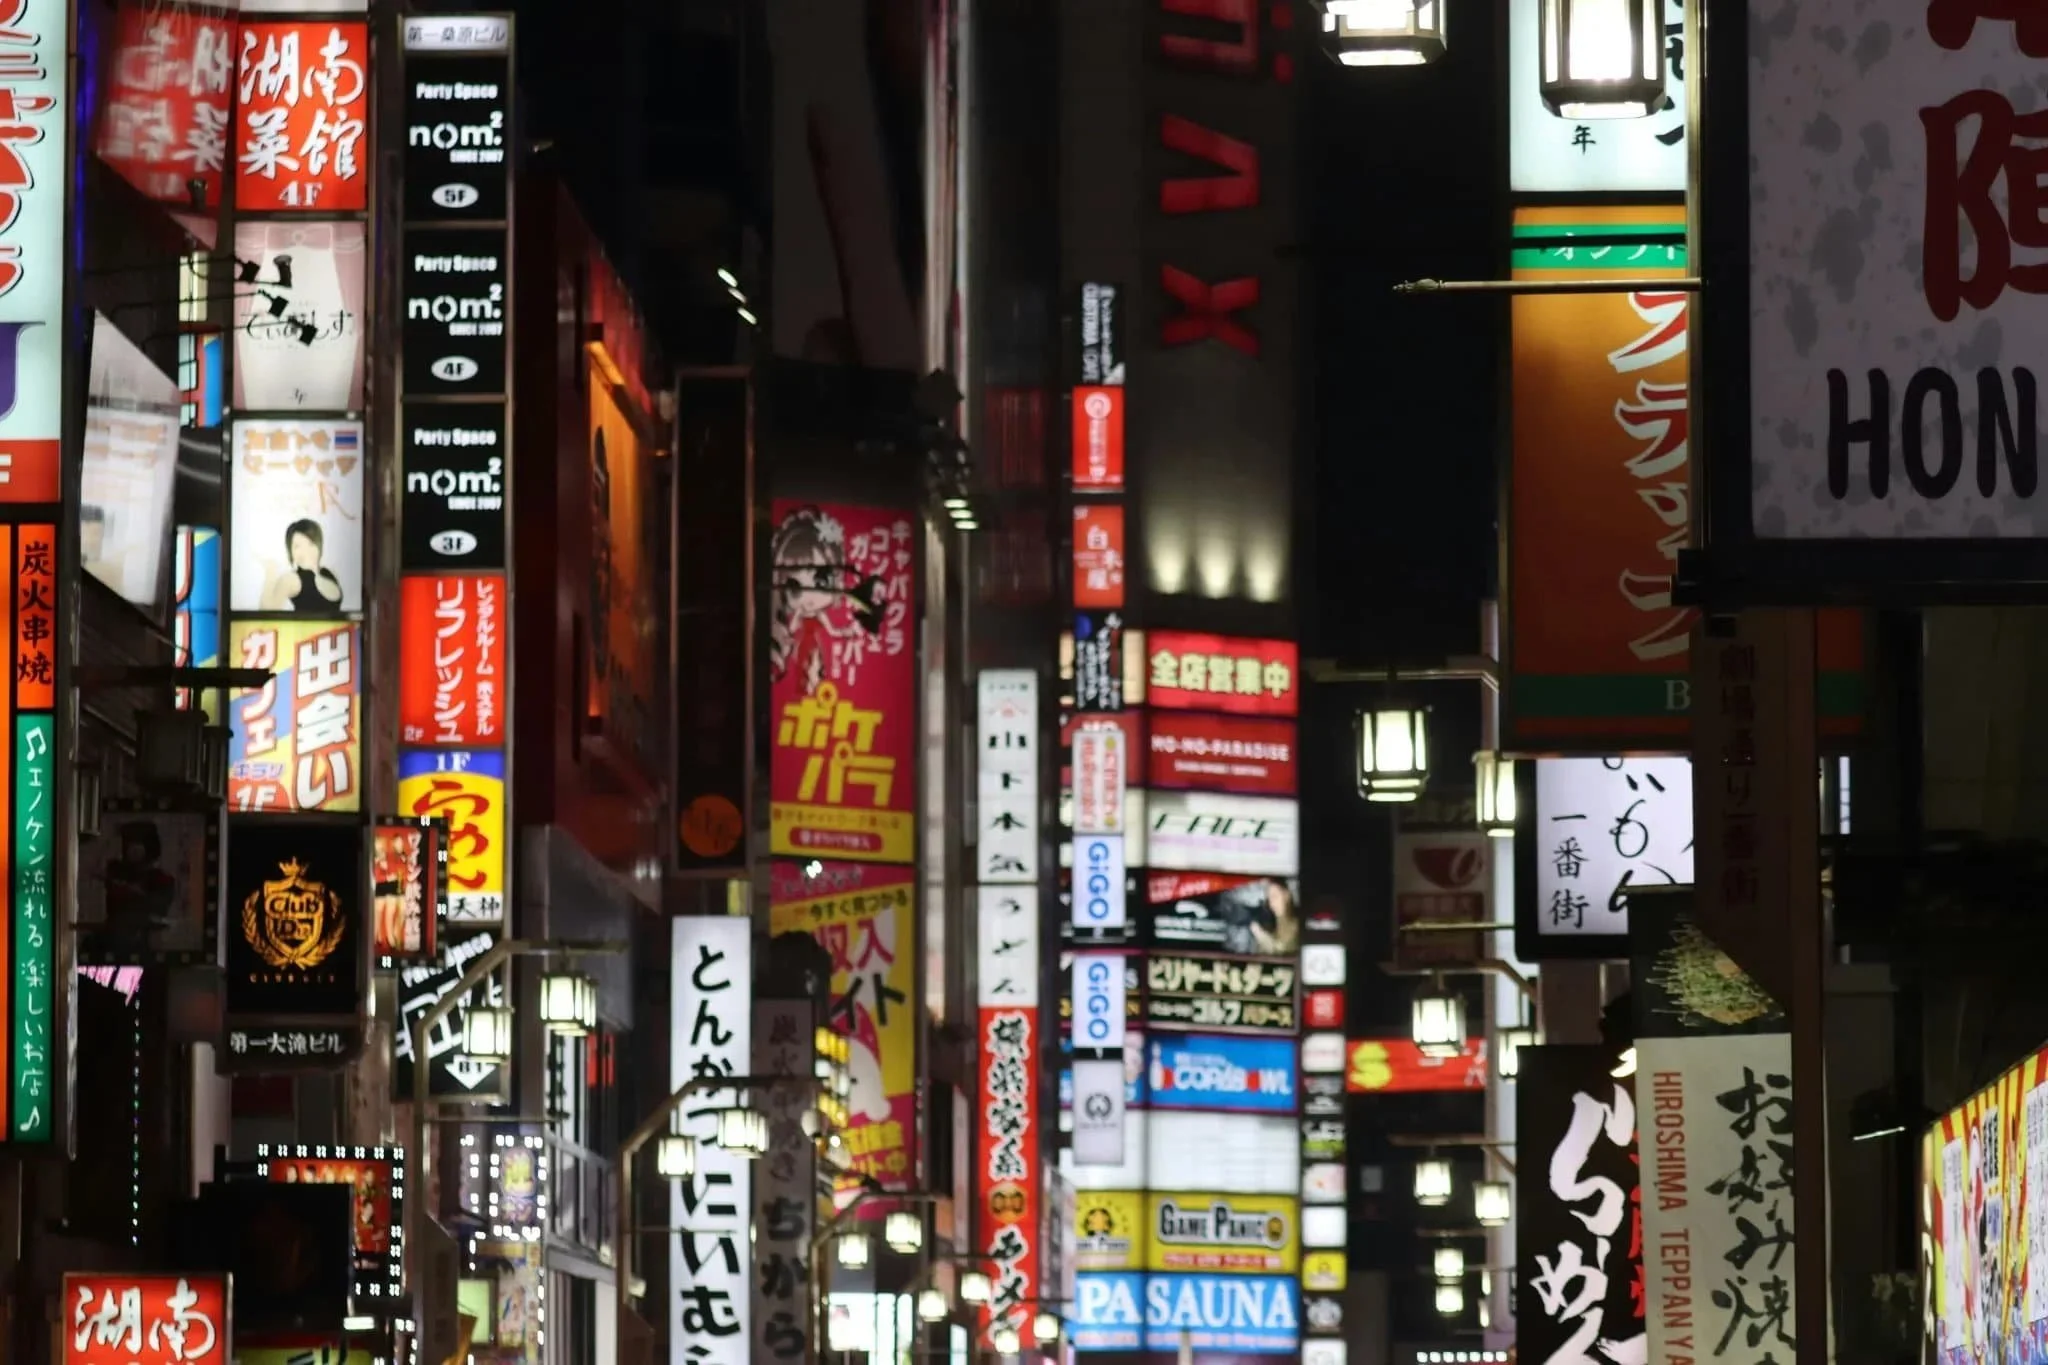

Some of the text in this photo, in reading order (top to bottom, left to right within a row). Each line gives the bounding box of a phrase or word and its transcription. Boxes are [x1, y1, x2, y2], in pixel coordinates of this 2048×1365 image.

[240, 27, 364, 106] 湖南
[416, 82, 498, 100] Party Space
[279, 181, 322, 207] 4F
[445, 189, 466, 203] 5F
[414, 254, 497, 273] Party Space
[444, 363, 465, 376] 4F
[414, 428, 496, 446] Party Space
[1826, 366, 2038, 499] HON
[443, 536, 464, 551] 3F
[887, 520, 911, 656] キャバクラ
[18, 540, 53, 685] 炭火串焼
[435, 578, 466, 742] リフレッシュ
[297, 631, 350, 810] 出会い
[437, 752, 472, 772] 1F
[236, 785, 278, 812] 1F
[1549, 813, 1591, 929] 一番街
[230, 1030, 345, 1055] 第一大滝ビル
[1653, 1072, 1688, 1212] HIROSHIMA
[1161, 1203, 1207, 1238] GAME
[74, 1278, 216, 1361] 湖南
[1146, 1279, 1298, 1328] SAUNA
